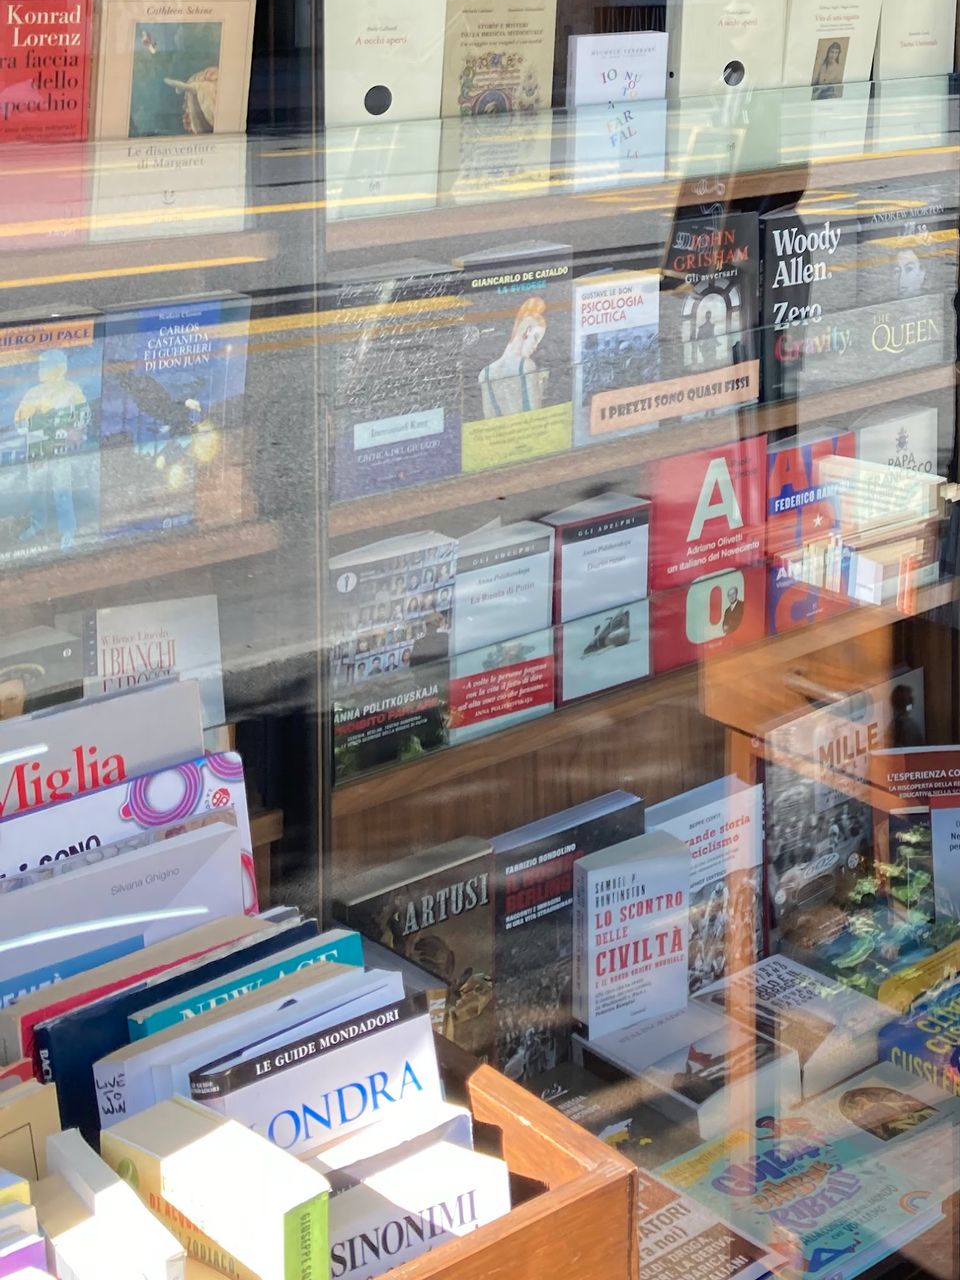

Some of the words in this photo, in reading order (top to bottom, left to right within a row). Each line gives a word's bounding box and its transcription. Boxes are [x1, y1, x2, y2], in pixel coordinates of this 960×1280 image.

[7, 4, 81, 25] Konrad
[12, 27, 81, 47] Lorenz
[25, 49, 78, 68] faccia
[31, 70, 78, 90] dello
[0, 92, 77, 120] pecchio
[772, 221, 841, 256] Woody
[673, 245, 749, 272] GRISHAM
[471, 273, 521, 288] GIANCARLO
[523, 272, 534, 281] DE
[535, 266, 569, 280] CATALDO
[685, 272, 699, 284] Gli
[701, 268, 738, 281] avversari
[581, 295, 644, 314] PSICOLOGIA
[582, 290, 608, 300] GUSTAVE
[609, 288, 618, 296] LE
[619, 286, 633, 295] BON
[581, 311, 627, 327] POLITICA
[773, 301, 823, 331] Zero
[57, 327, 91, 341] PACE
[159, 323, 200, 337] CARLOS
[872, 318, 941, 354] QUEEN
[158, 358, 181, 370] DON
[183, 354, 210, 368] JUAN
[609, 401, 653, 418] PREZZI
[655, 392, 684, 410] SONO
[687, 383, 722, 401] QUASI
[724, 376, 750, 394] FISSI
[888, 453, 915, 470] PAPA
[686, 456, 744, 543] A
[775, 489, 815, 512] FEDERICO
[598, 517, 636, 532] ADELPHI
[686, 540, 716, 556] Adriano
[717, 533, 743, 546] Olivetti
[667, 566, 678, 575] un
[679, 558, 707, 572] italiano
[708, 551, 720, 562] del
[721, 540, 760, 558] Novecento
[110, 638, 176, 677] BIANCHI
[334, 708, 360, 724] ANNA
[819, 722, 879, 767] MILLE
[887, 769, 947, 782] L'ESPERIENZA
[897, 782, 933, 791] RISCOPERTA
[720, 815, 751, 834] storia
[692, 834, 740, 859] ciclismo
[949, 841, 960, 852] per
[506, 857, 538, 876] FABRIZIO
[539, 843, 577, 865] RONDOLINO
[111, 879, 144, 897] Silvana
[145, 867, 181, 886] Ghigino
[595, 875, 627, 895] SAMUEL
[402, 871, 490, 937] ARTUSI
[595, 884, 646, 909] HUNTINGTON
[595, 910, 613, 930] LO
[620, 891, 683, 922] SCONTRO
[595, 926, 628, 947] DELLE
[595, 926, 684, 977] CIVILTÀ
[256, 1059, 272, 1076] LE
[275, 1042, 316, 1068] GUIDE
[319, 1009, 400, 1051] MONDADORI
[95, 1073, 126, 1090] LIVE
[254, 1059, 425, 1150] ONDRA
[329, 1188, 478, 1279] SINONIMI
[691, 1234, 736, 1265] DERIVA
